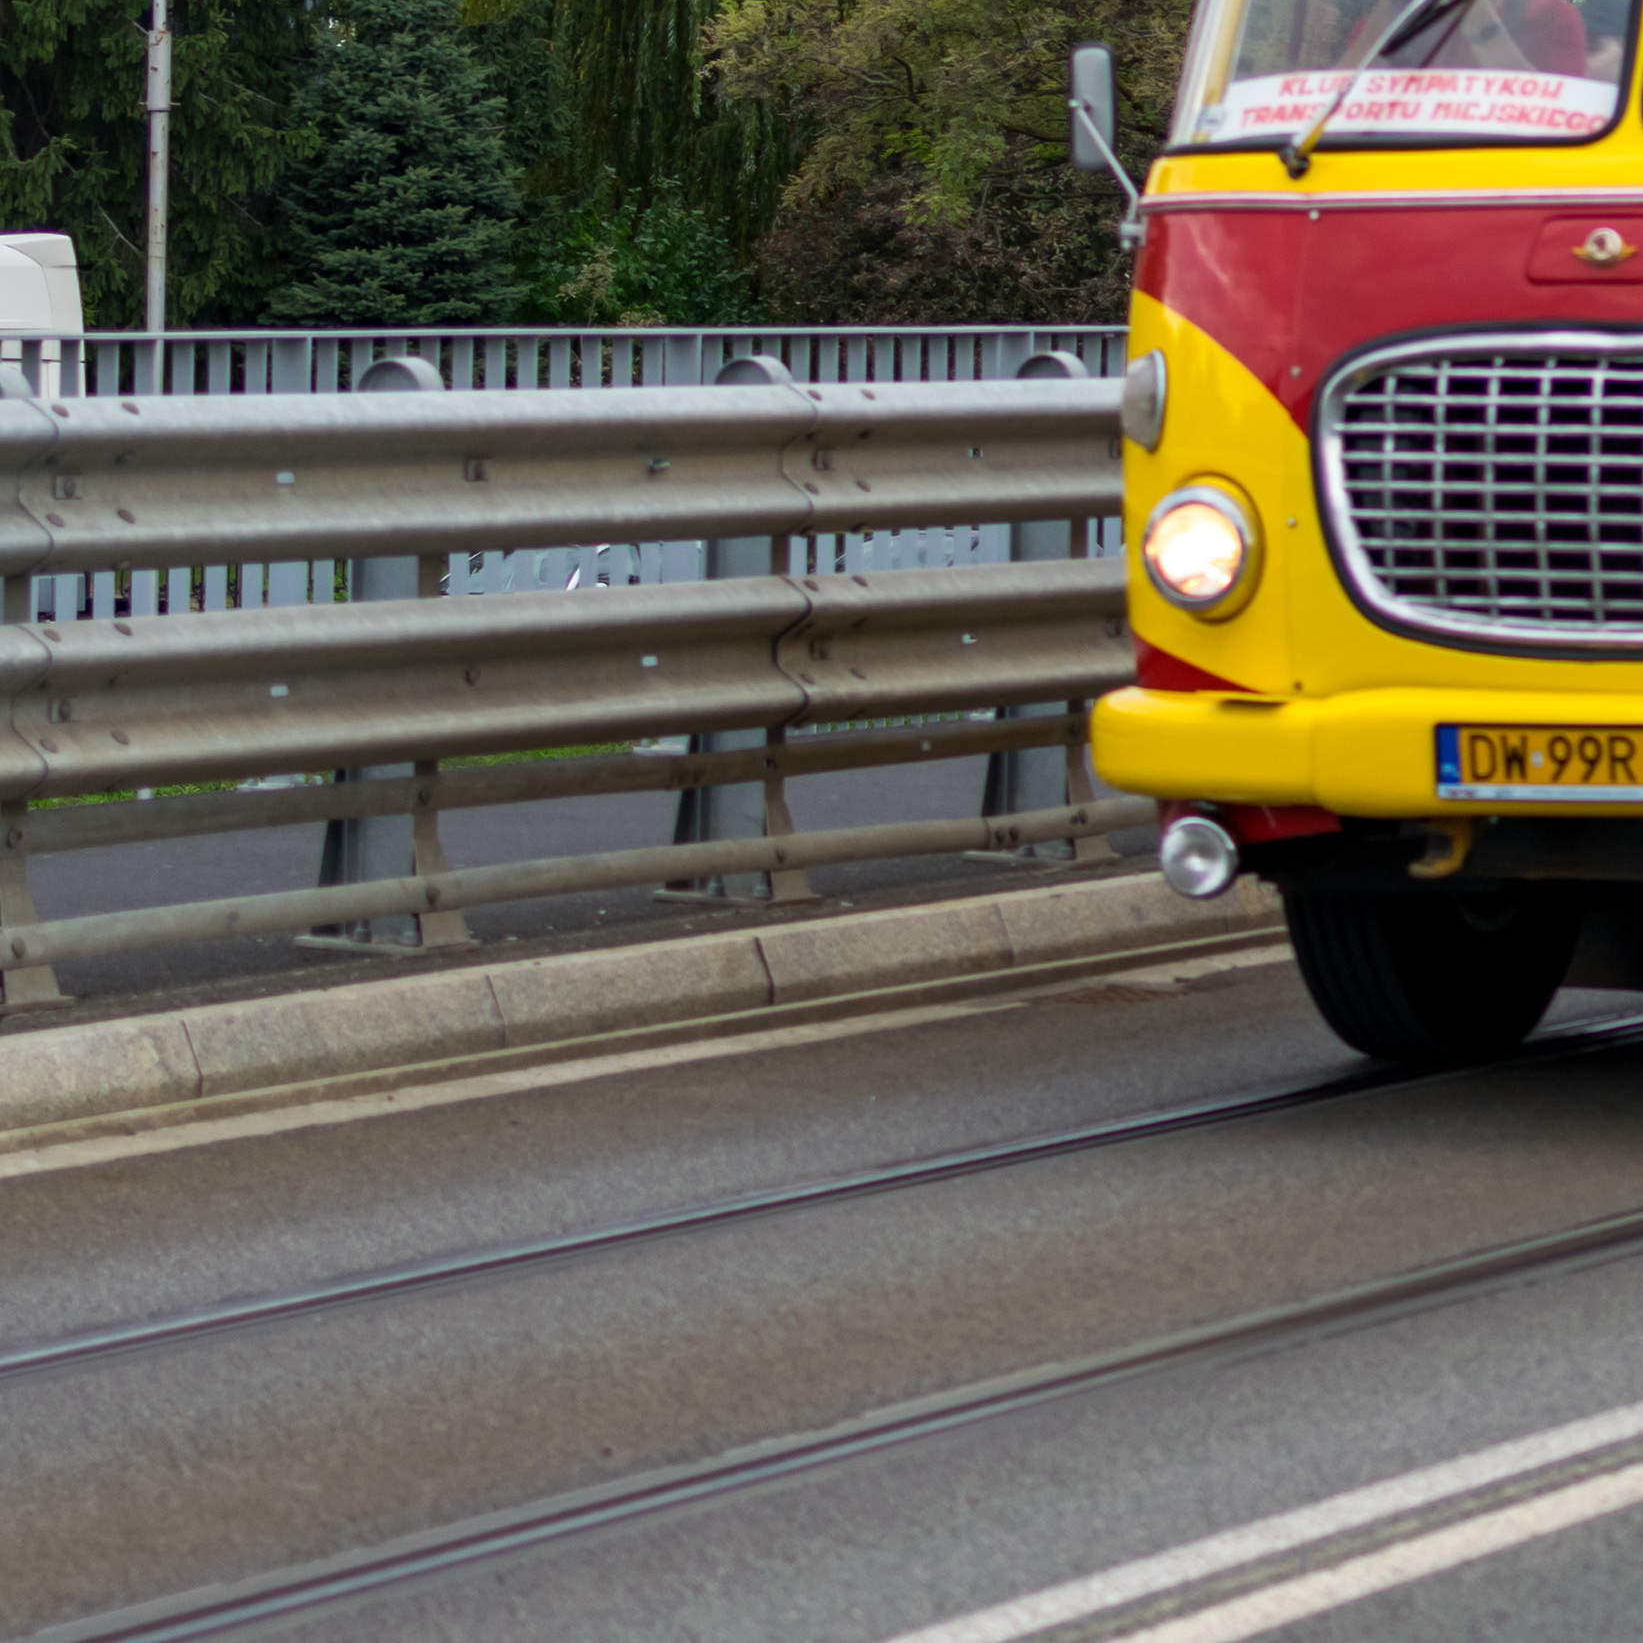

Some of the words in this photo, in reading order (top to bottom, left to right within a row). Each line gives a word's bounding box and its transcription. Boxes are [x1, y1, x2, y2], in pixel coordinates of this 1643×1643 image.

[1240, 101, 1421, 128] TRANSORTU
[1430, 102, 1609, 133] MIEJSKIEGO
[1469, 734, 1528, 782] DW
[1548, 734, 1637, 784] 99R
